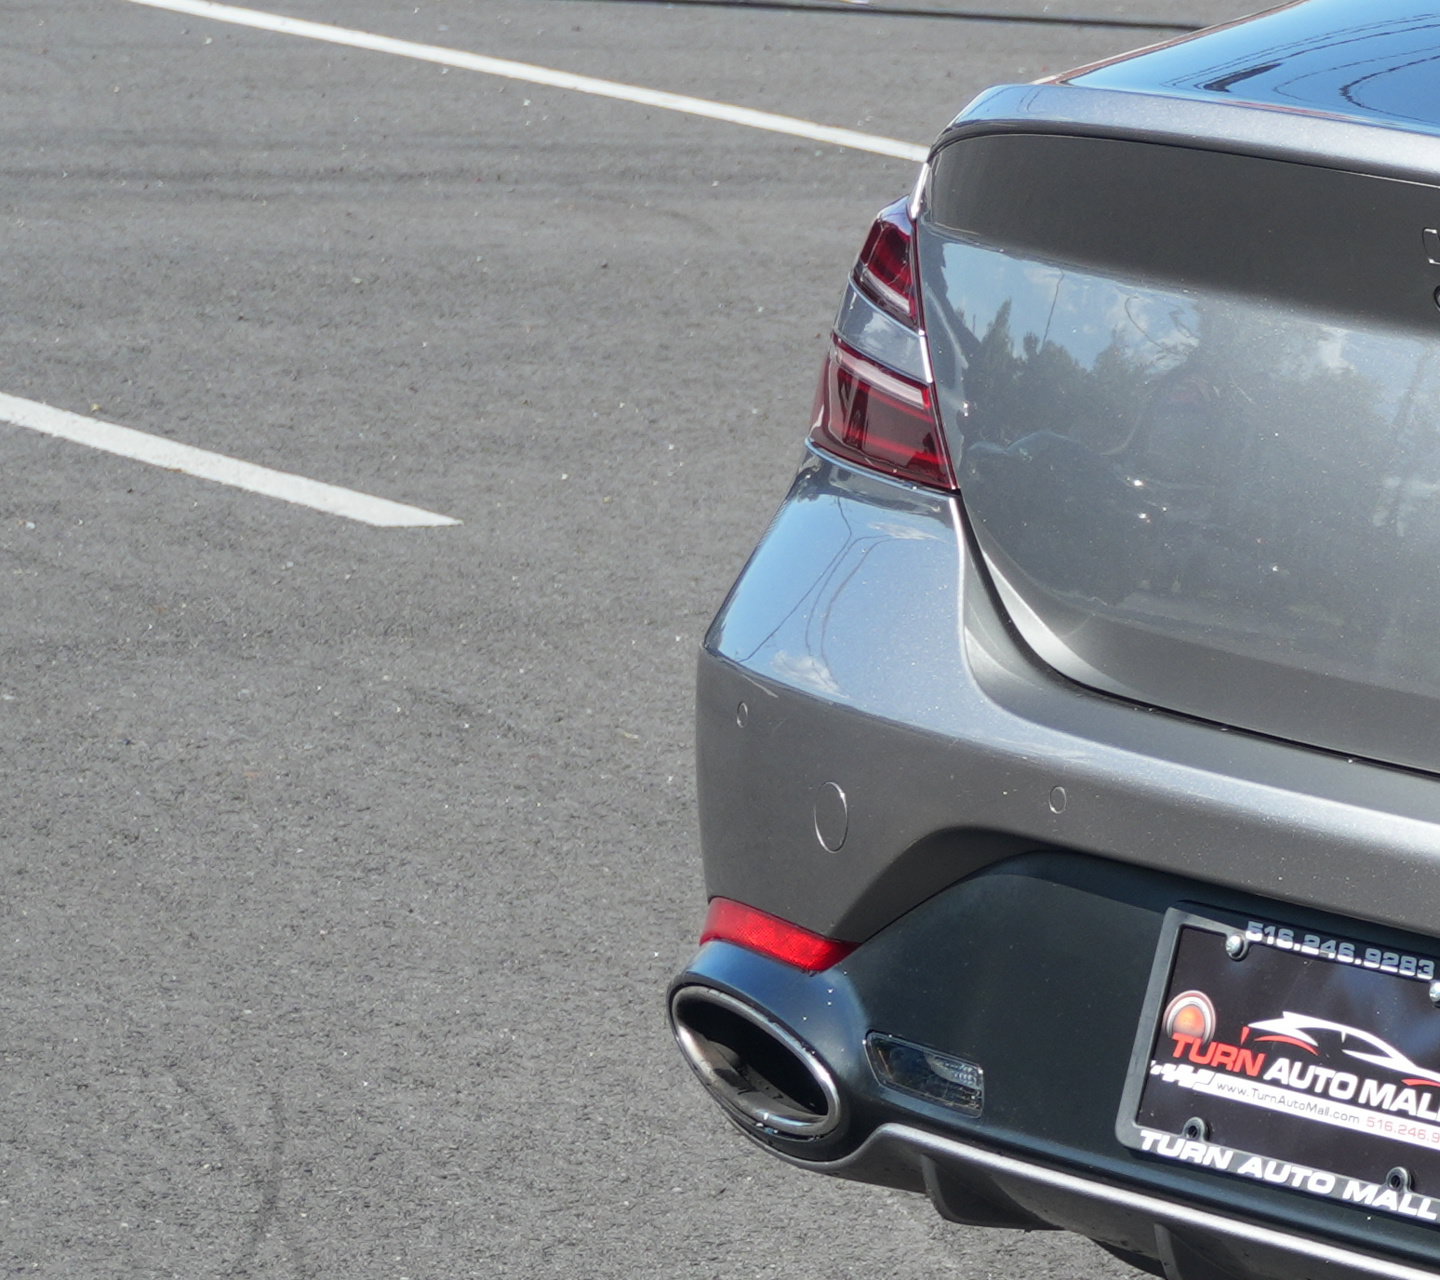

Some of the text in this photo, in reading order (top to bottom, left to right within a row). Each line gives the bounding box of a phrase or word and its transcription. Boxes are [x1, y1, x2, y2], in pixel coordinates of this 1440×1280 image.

[1245, 920, 1435, 981] 516.246.9283
[1171, 1032, 1266, 1078] TURN
[1263, 1057, 1358, 1102] AUTO
[1216, 1080, 1361, 1125] www.TurnAutoMall.com
[1140, 1130, 1438, 1221] TURN AUTO MALL
